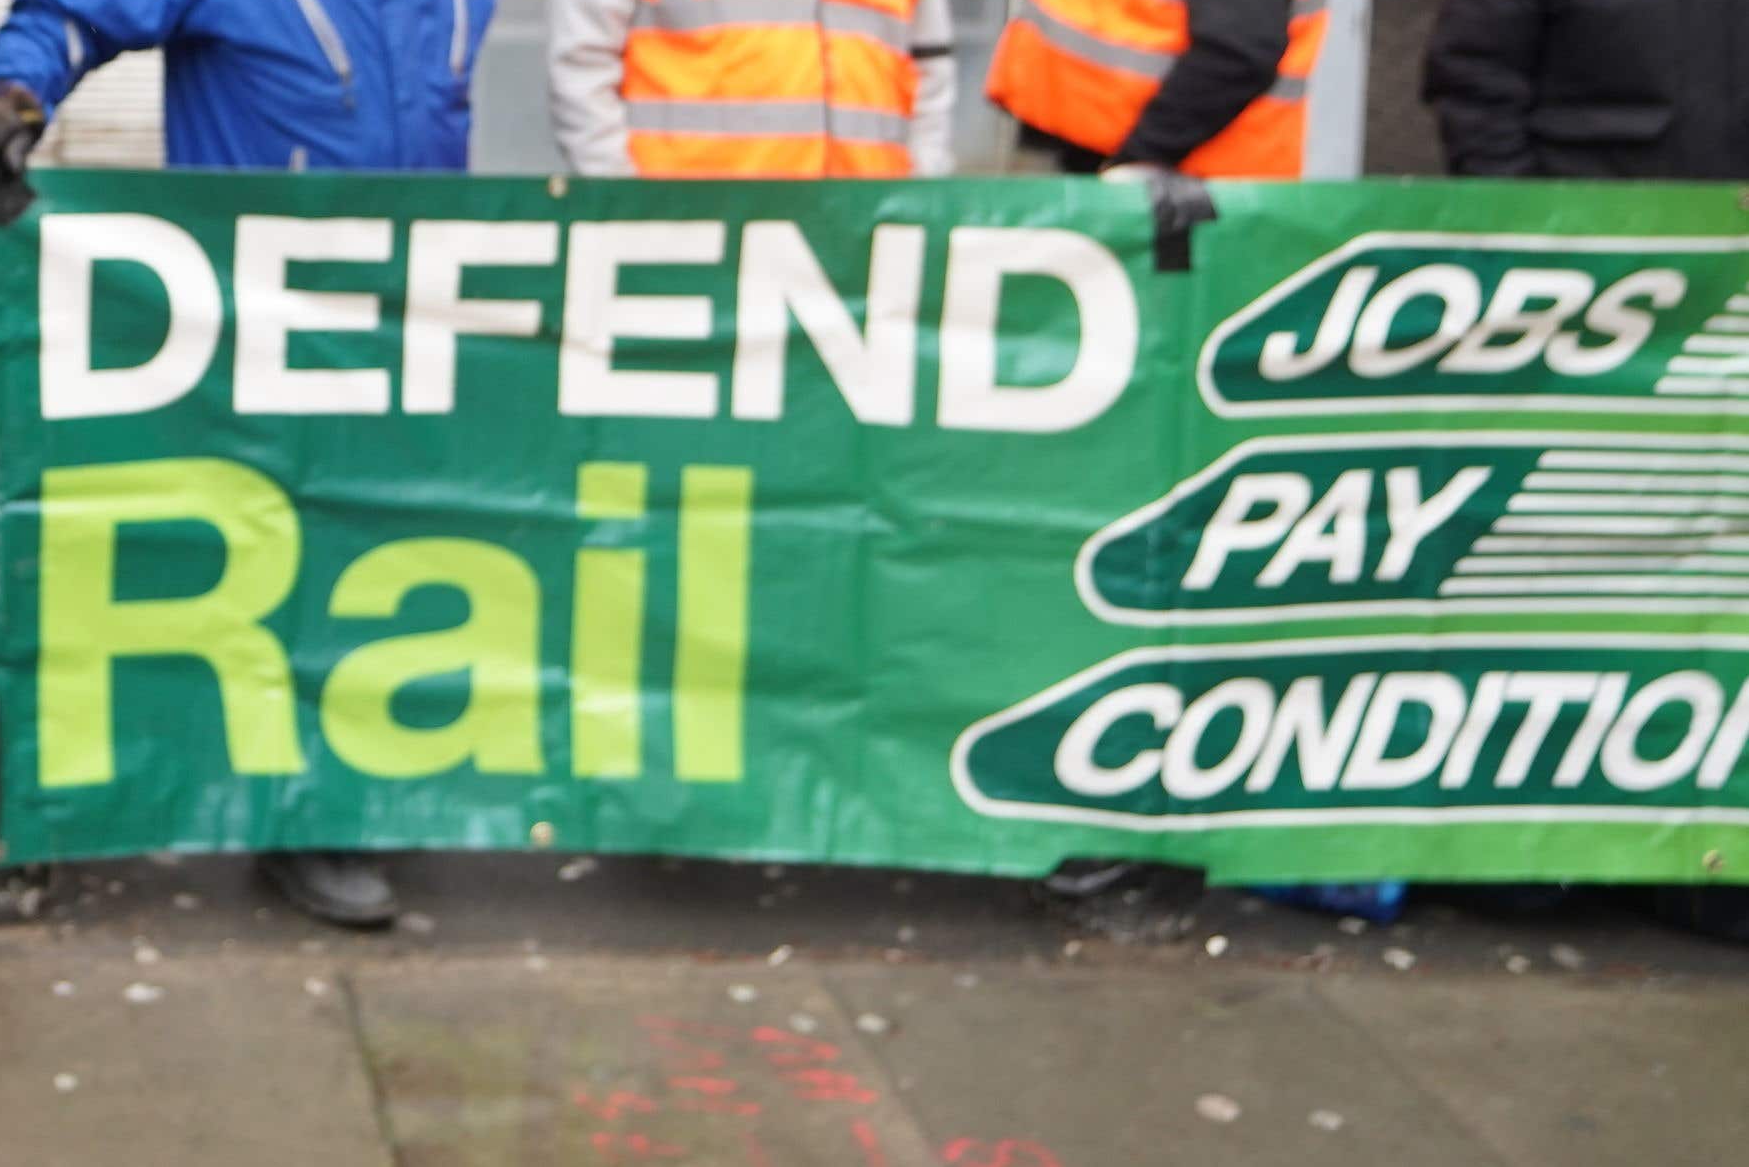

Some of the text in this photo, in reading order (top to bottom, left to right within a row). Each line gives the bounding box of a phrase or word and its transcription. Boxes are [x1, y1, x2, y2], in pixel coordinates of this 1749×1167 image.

[40, 213, 1138, 431] DEFEND
[1258, 264, 1688, 381] JOBS
[1181, 466, 1492, 591] PAY
[39, 457, 753, 787] Rail
